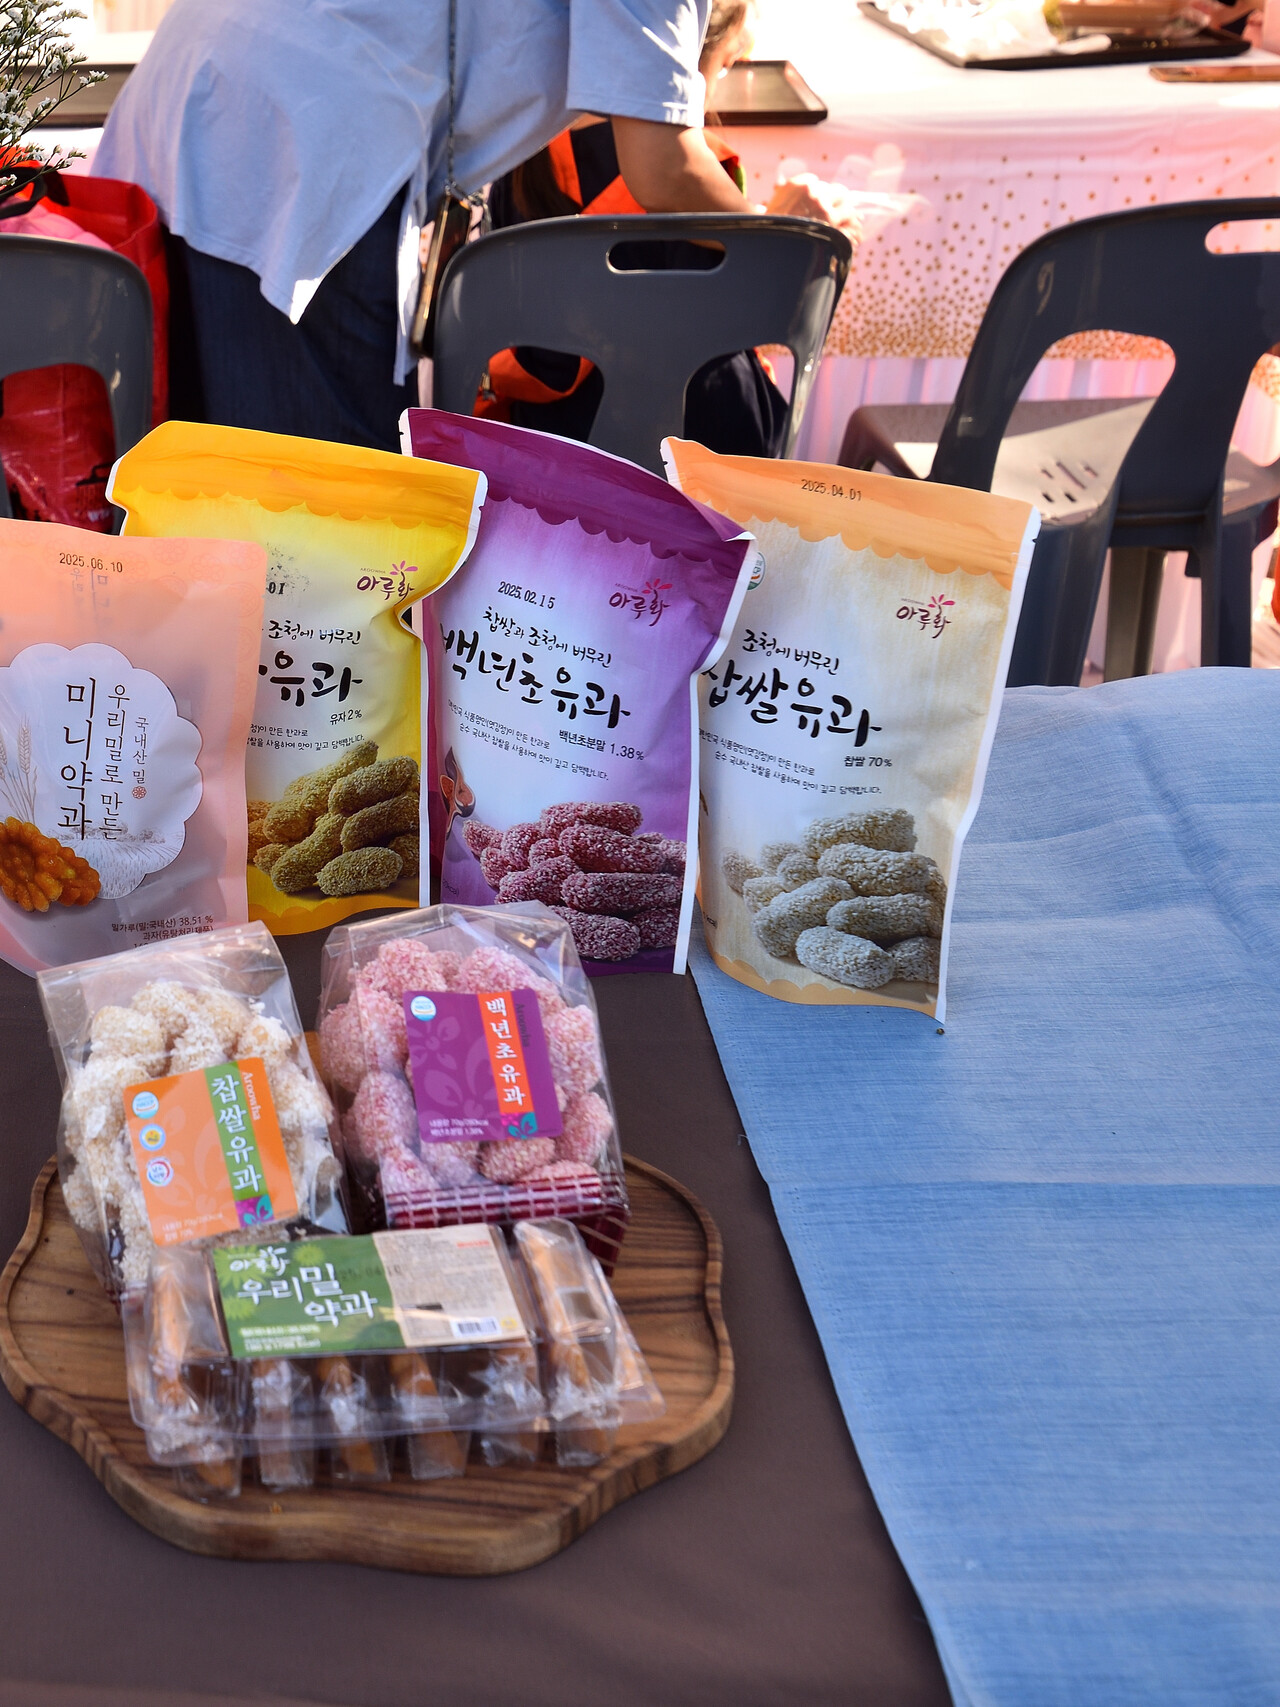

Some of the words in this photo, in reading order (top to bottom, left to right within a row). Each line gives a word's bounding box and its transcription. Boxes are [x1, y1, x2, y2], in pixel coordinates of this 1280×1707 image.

[801, 478, 863, 502] 2025.04.01
[59, 552, 123, 573] 2025.06.10
[356, 571, 415, 606] 아루화
[609, 590, 671, 627] 아루화
[896, 604, 952, 640] 아루화
[268, 619, 314, 640] 조청에
[319, 628, 361, 645] 버무린
[483, 606, 525, 639] 찹쌀과
[528, 626, 567, 652] 조청에
[572, 645, 611, 668] 버무린
[742, 628, 791, 659] 조청에
[794, 648, 840, 676] 버무린
[258, 650, 363, 707] 유과
[440, 623, 631, 729] 백년초유과
[100, 684, 130, 784] 우리밀로
[133, 717, 149, 765] 국내산
[247, 737, 263, 747] 쌀을
[269, 726, 283, 736] 만든
[286, 728, 308, 737] 한과로
[459, 722, 470, 733] 순수
[472, 727, 491, 743] 국내산
[559, 729, 606, 753] 백년초분말
[610, 743, 645, 761] 1.38%
[58, 677, 96, 841] 미니약과
[132, 769, 145, 784] 밀
[843, 756, 866, 768] 찹쌀
[868, 756, 893, 767] 70%
[99, 792, 123, 840] 만든
[111, 918, 176, 932] 밀가루(밀:국내산)
[179, 916, 201, 926] 38.51
[485, 997, 526, 1106] 백년초유과
[211, 1074, 262, 1193] 찹쌀유과
[237, 1263, 343, 1305] 우리밀
[304, 1290, 378, 1328] 약과
